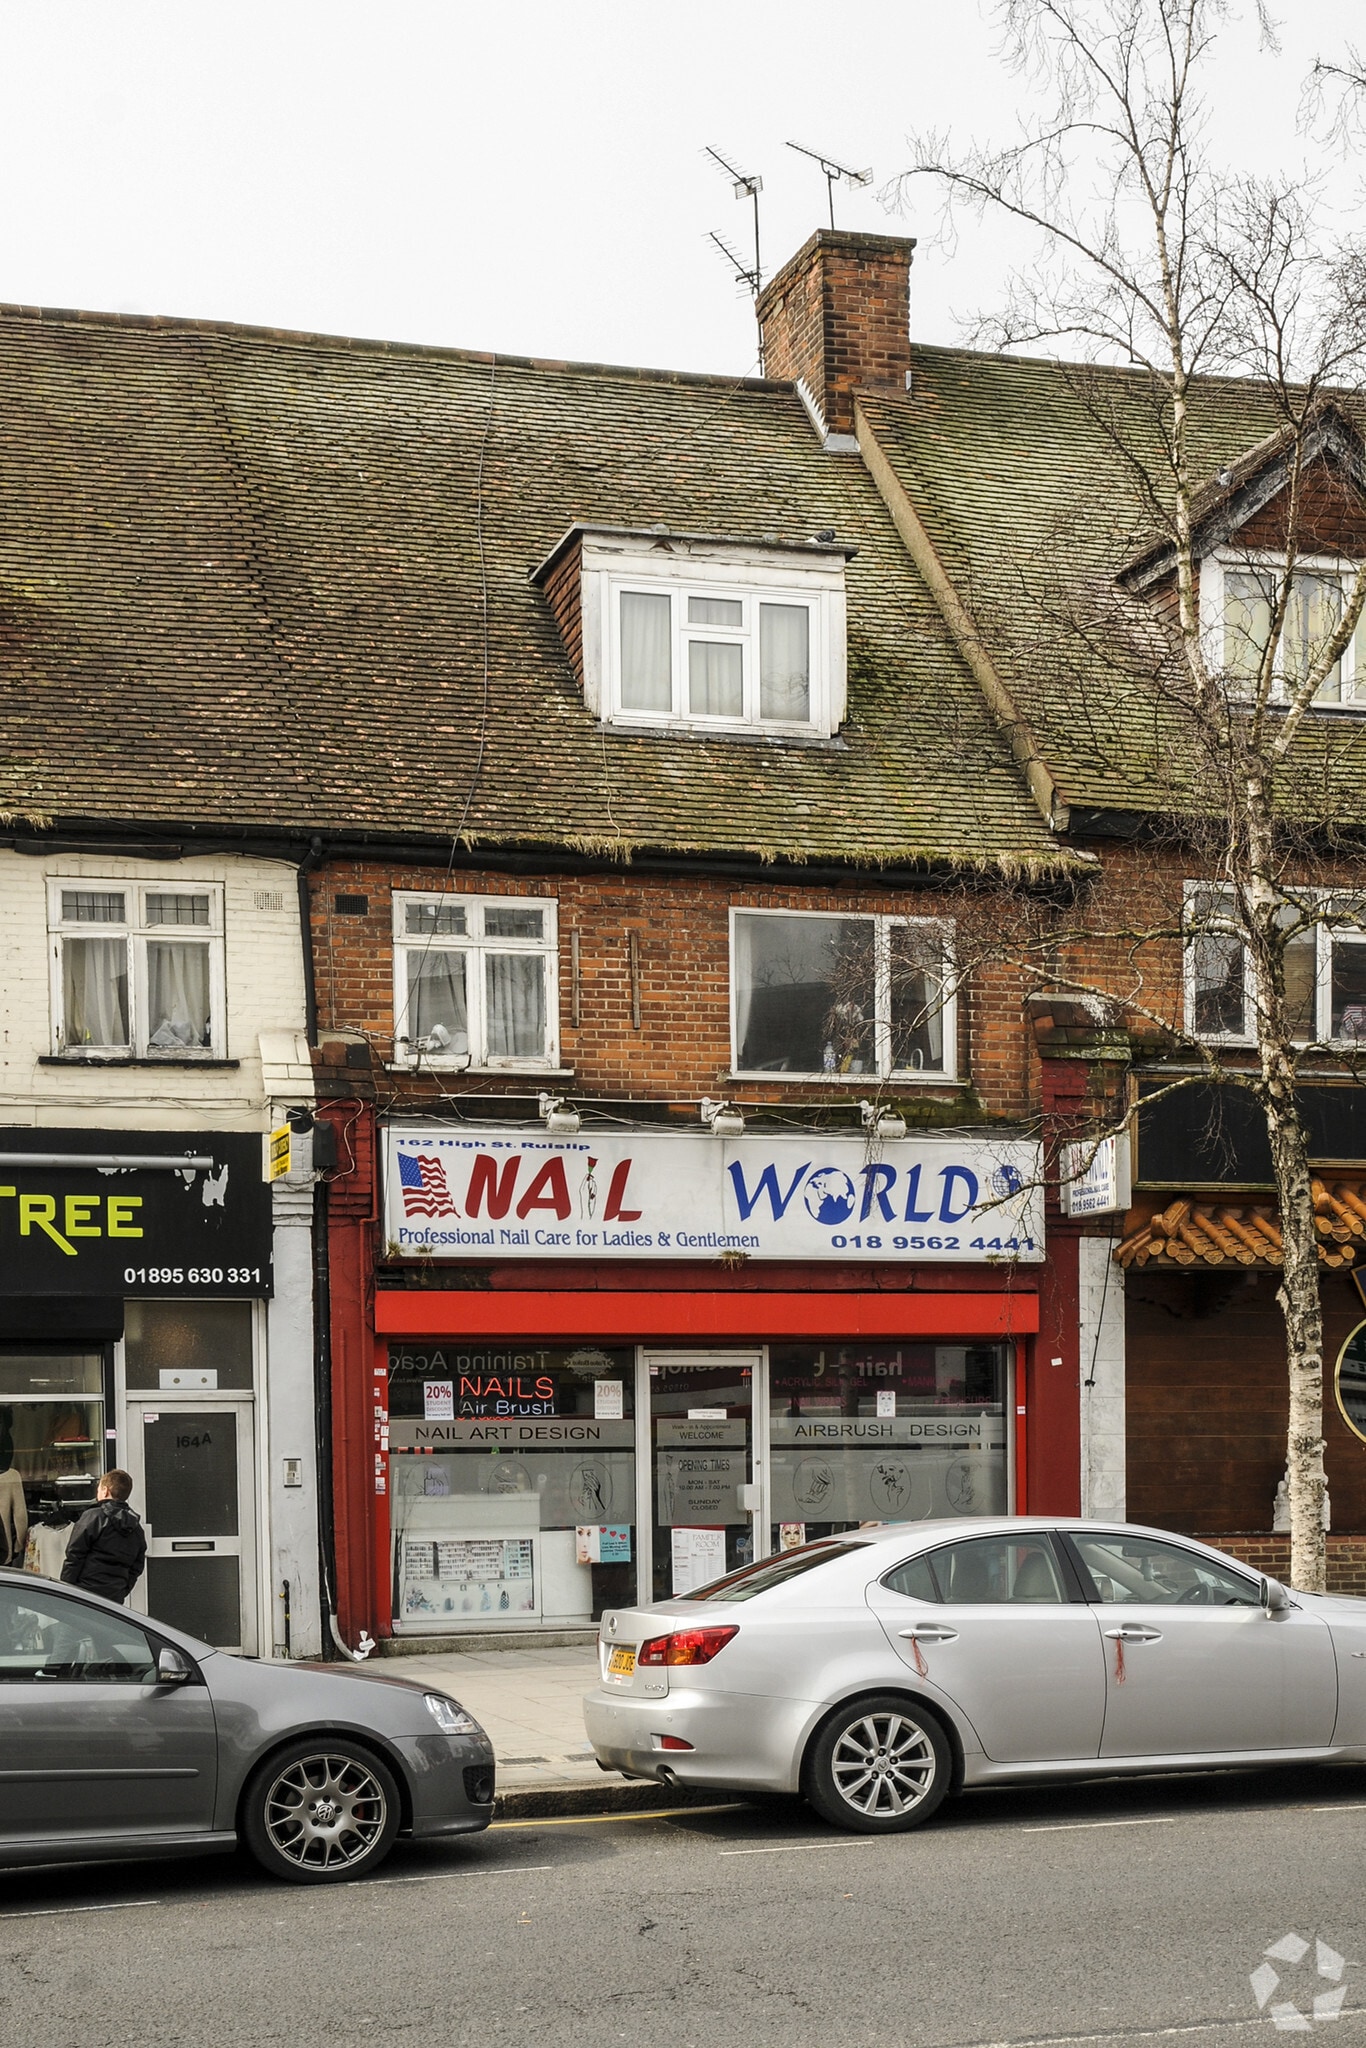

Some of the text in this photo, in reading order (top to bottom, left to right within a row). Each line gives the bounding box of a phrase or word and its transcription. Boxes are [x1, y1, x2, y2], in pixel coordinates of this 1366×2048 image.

[395, 1139, 591, 1151] 162 High St. Ruislip
[398, 1226, 760, 1249] Professional Nail Care for Ladies & Gentlemen
[831, 1235, 1035, 1252] 018 9562 4441
[124, 1267, 262, 1284] 01895 630 331
[426, 1385, 452, 1399] 20%
[459, 1376, 554, 1399] NAILS
[597, 1384, 621, 1397] 20%
[459, 1400, 555, 1415] Air Brush
[415, 1427, 600, 1440] NAIL ART DESIGN
[679, 1431, 725, 1440] WELCOME
[794, 1424, 982, 1438] AIRBRUSH DESIGN
[678, 1459, 731, 1472] OPENING TIMES
